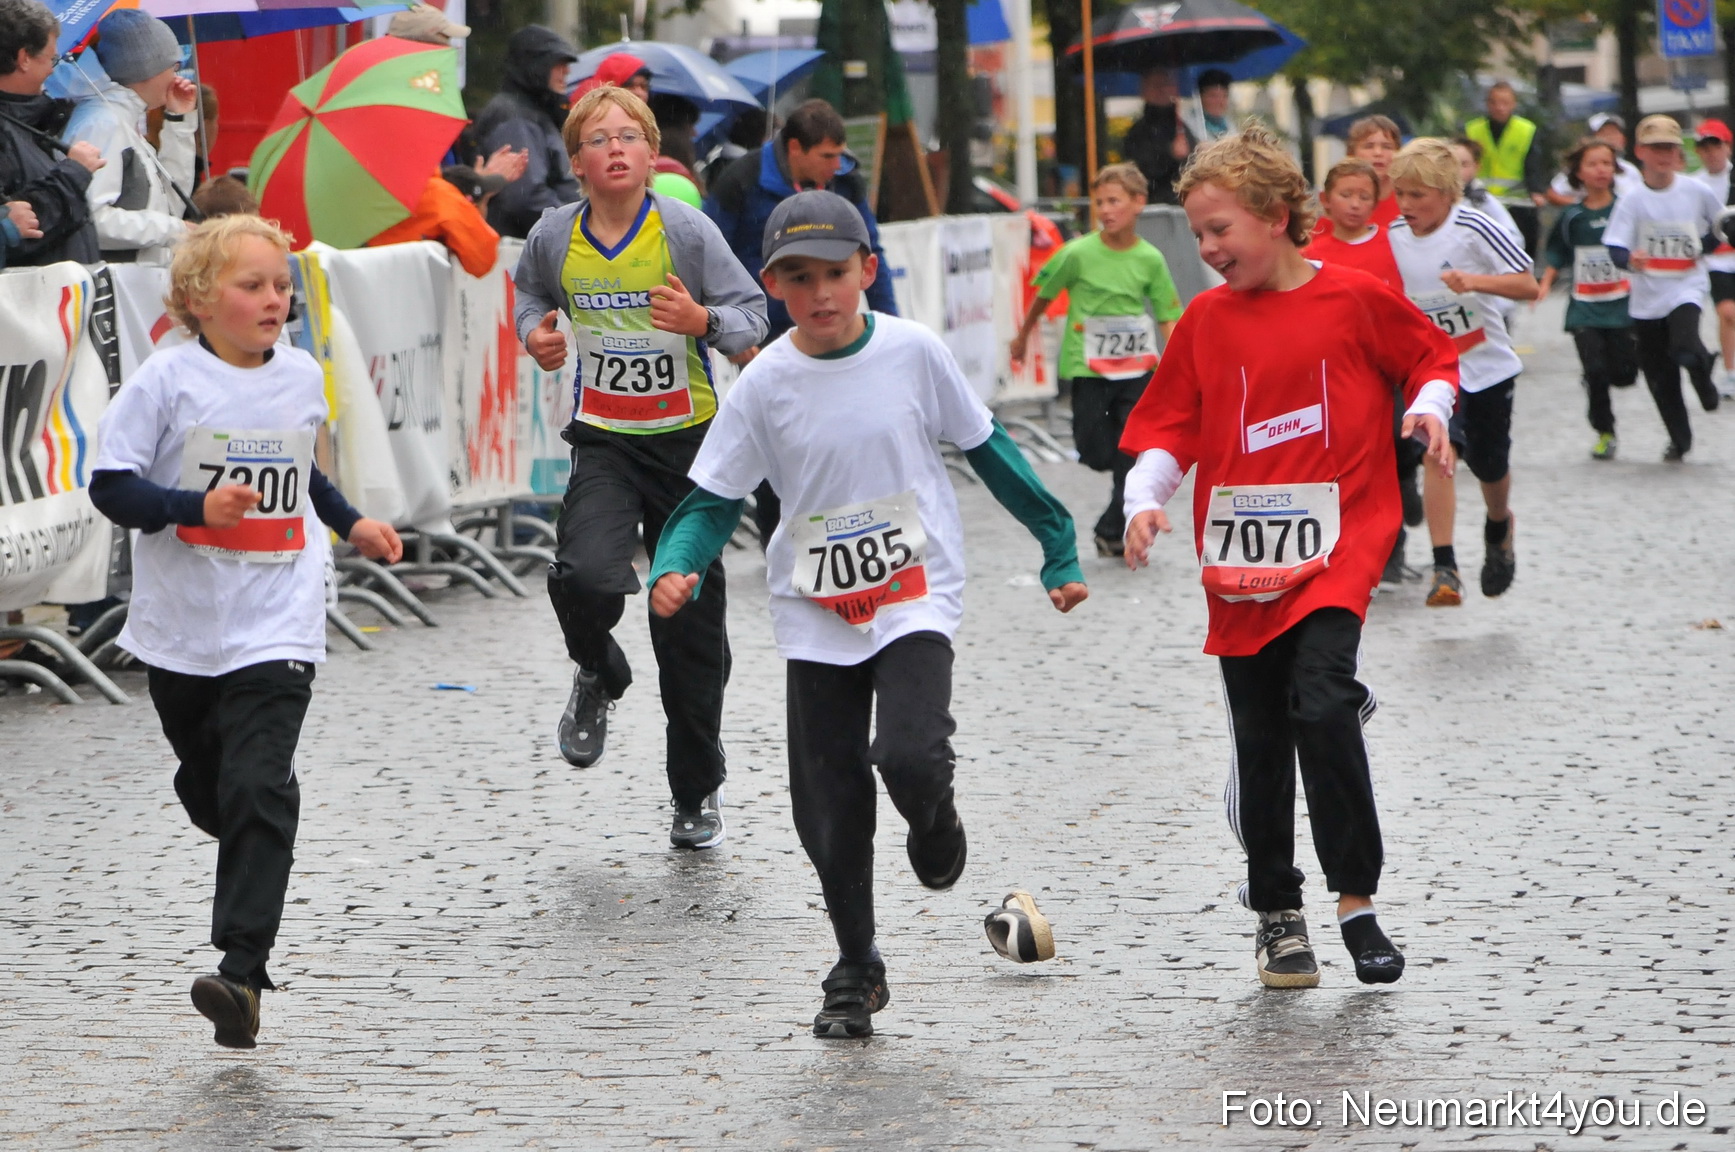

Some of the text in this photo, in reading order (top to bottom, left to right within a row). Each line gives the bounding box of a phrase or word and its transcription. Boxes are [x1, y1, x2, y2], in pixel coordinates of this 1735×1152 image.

[571, 277, 621, 290] TEAM
[573, 291, 652, 310] BOCK
[602, 337, 651, 349] BOCK
[1095, 332, 1149, 356] 7242
[590, 351, 675, 393] 7239
[1268, 418, 1301, 438] DEHN
[227, 440, 282, 454] BOCK
[1233, 494, 1292, 508] BOCK
[825, 509, 873, 532] BOCK
[1211, 518, 1322, 564] 7070
[809, 528, 912, 593] 7085
[1239, 573, 1287, 590] Louis
